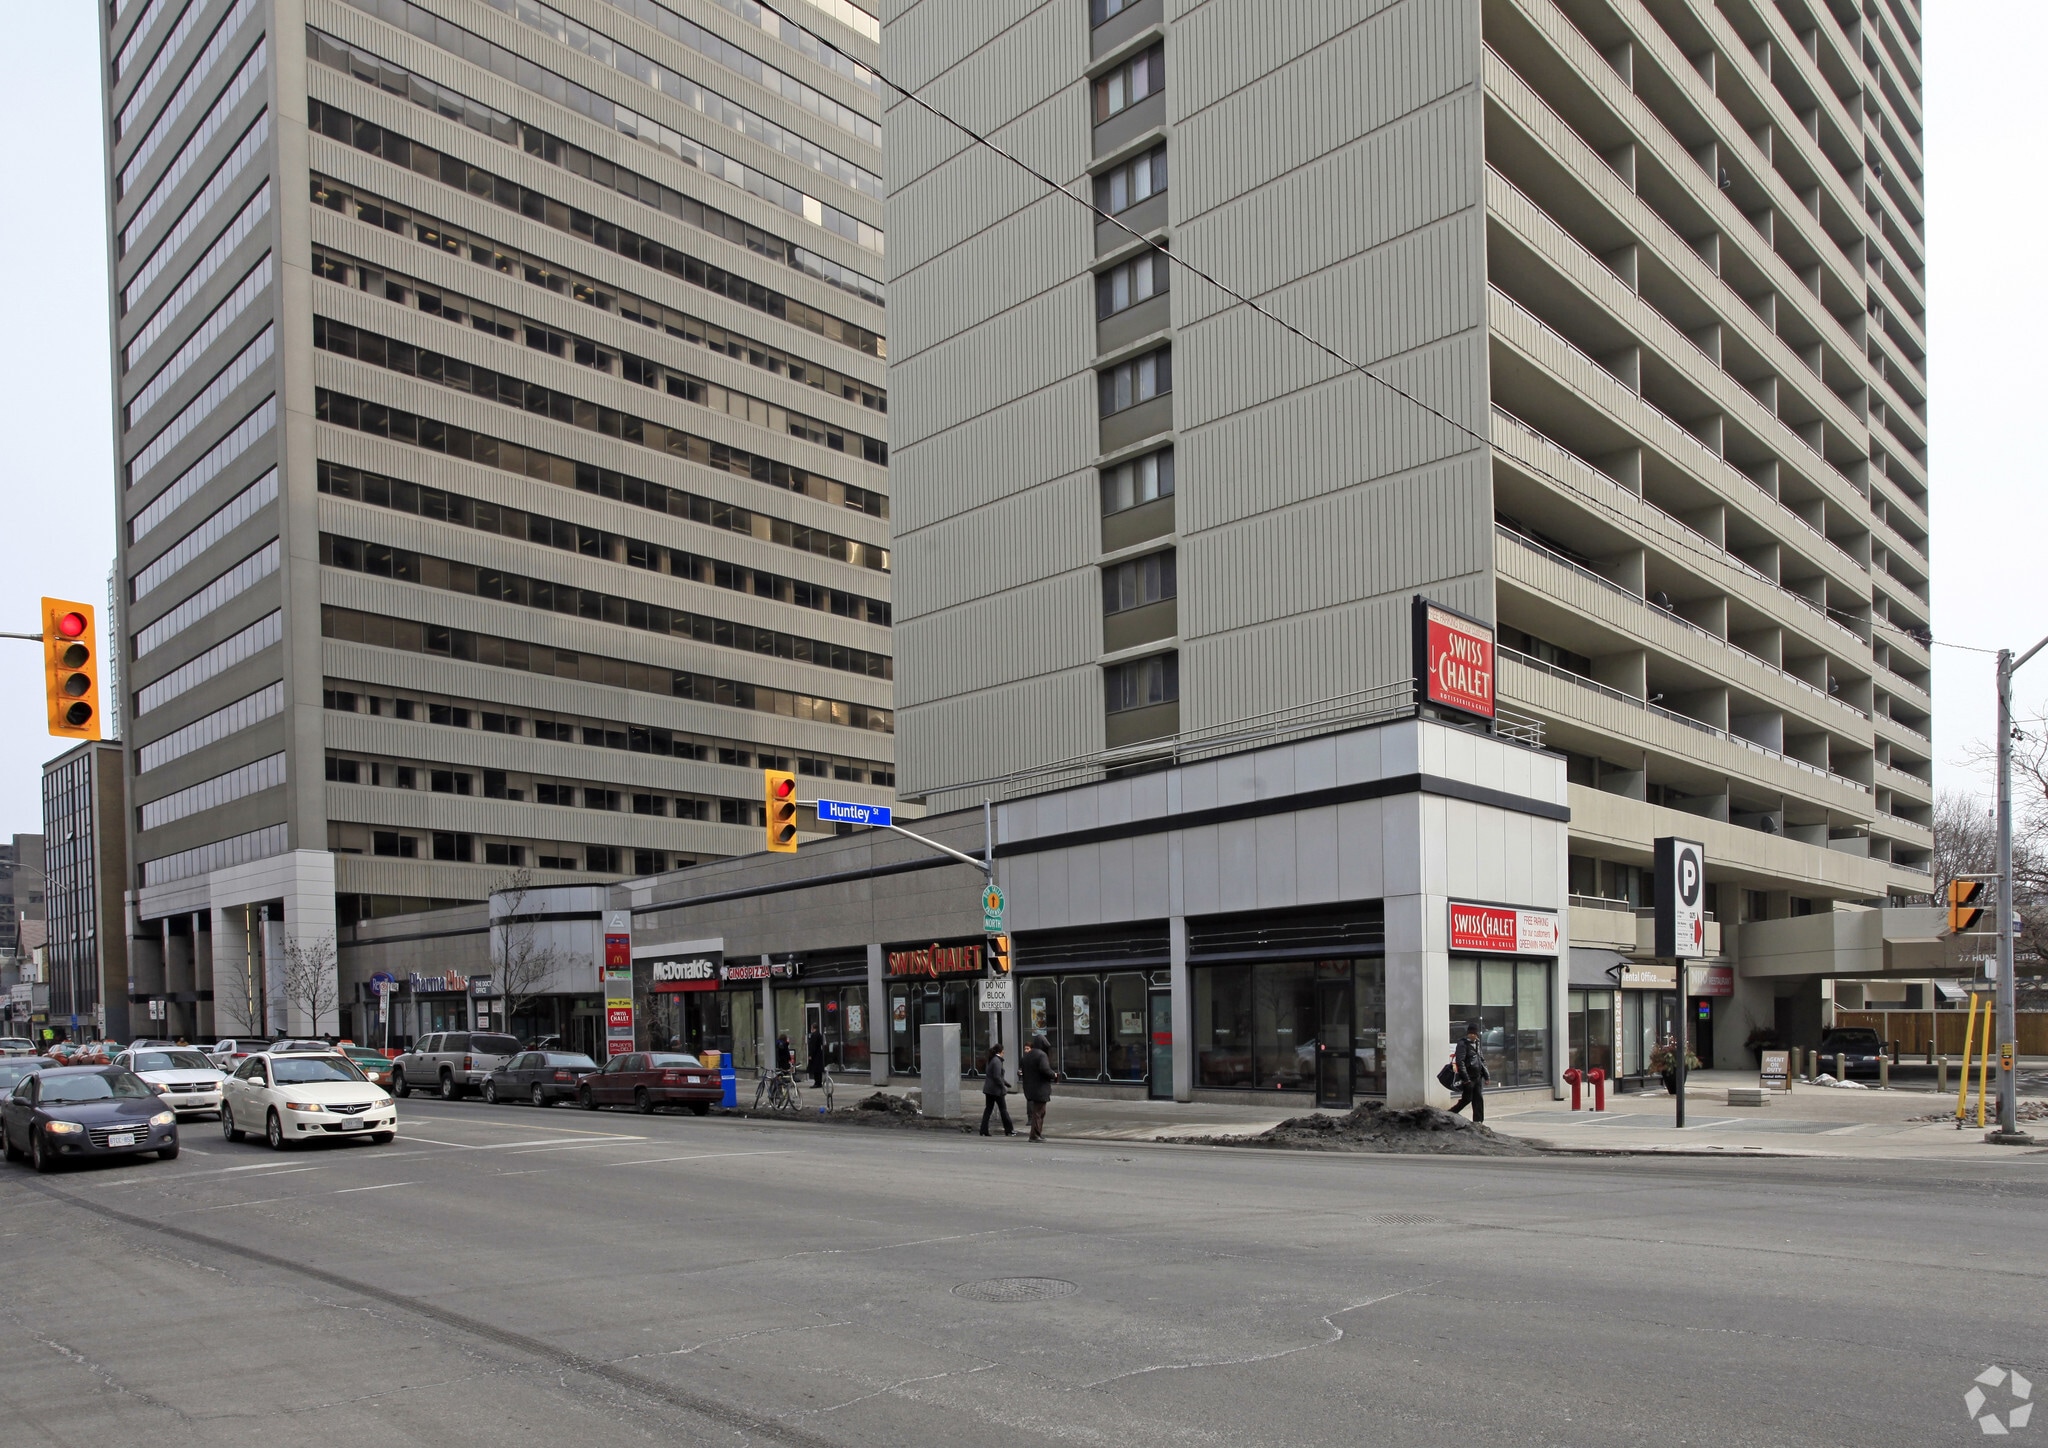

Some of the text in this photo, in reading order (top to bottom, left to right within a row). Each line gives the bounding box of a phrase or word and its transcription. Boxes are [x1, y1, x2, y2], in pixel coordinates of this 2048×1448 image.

[1448, 632, 1482, 666] SWISS
[1439, 651, 1490, 699] CHALET
[1440, 692, 1471, 707] ROTISSERIE
[1476, 704, 1490, 713] GRILL
[830, 803, 870, 823] Huntley
[1683, 860, 1696, 897] P
[985, 918, 1002, 928] NORTH
[1454, 912, 1514, 938] SWISS CHALET
[1523, 915, 1549, 927] FREE PARKING
[889, 942, 982, 979] SWISS CHALET
[653, 959, 714, 981] McDonald's
[748, 965, 770, 979] PIZZA
[1621, 971, 1640, 982] Rental
[1640, 972, 1657, 983] Office
[985, 981, 1007, 989] DO NOT
[986, 991, 1006, 999] BLOCK
[981, 1001, 1012, 1010] INTERSECTION
[610, 1014, 630, 1022] CHALET
